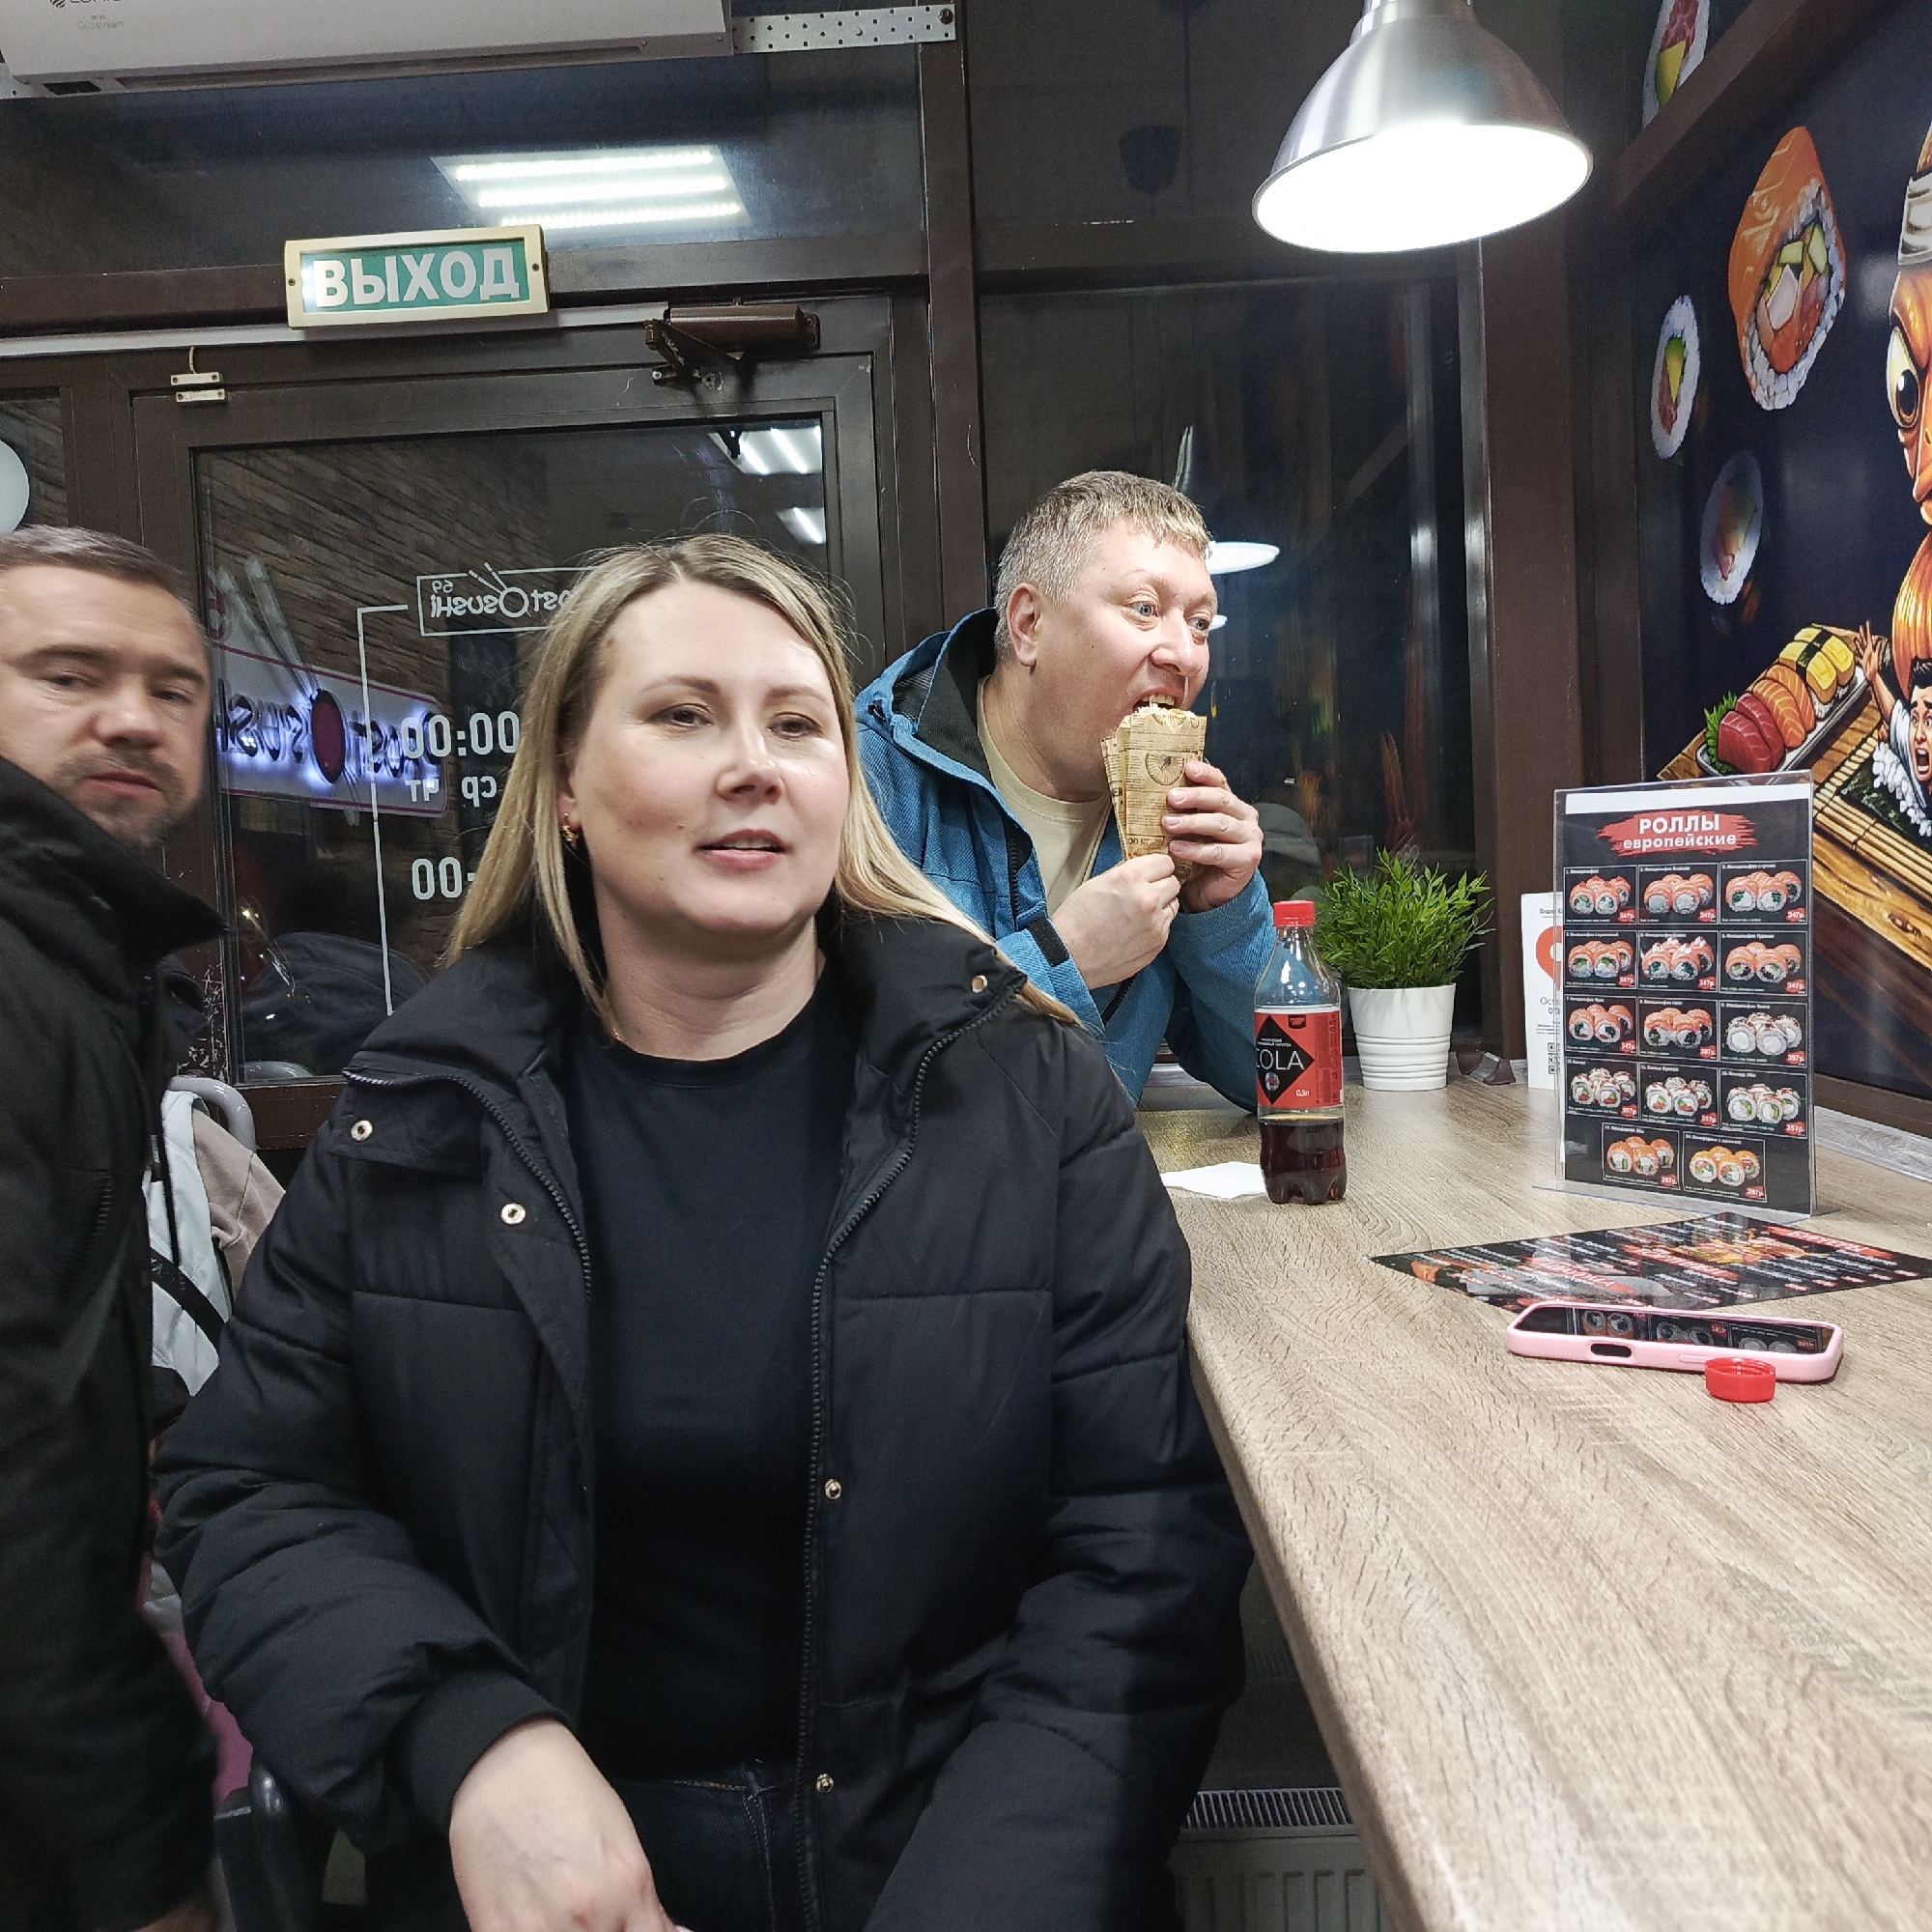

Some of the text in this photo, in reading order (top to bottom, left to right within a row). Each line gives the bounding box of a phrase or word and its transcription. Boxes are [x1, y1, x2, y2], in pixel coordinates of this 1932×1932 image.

[313, 247, 520, 308] ВЫХОД
[1638, 814, 1719, 834] РОЛЛЫ
[1623, 834, 1737, 852] европейские
